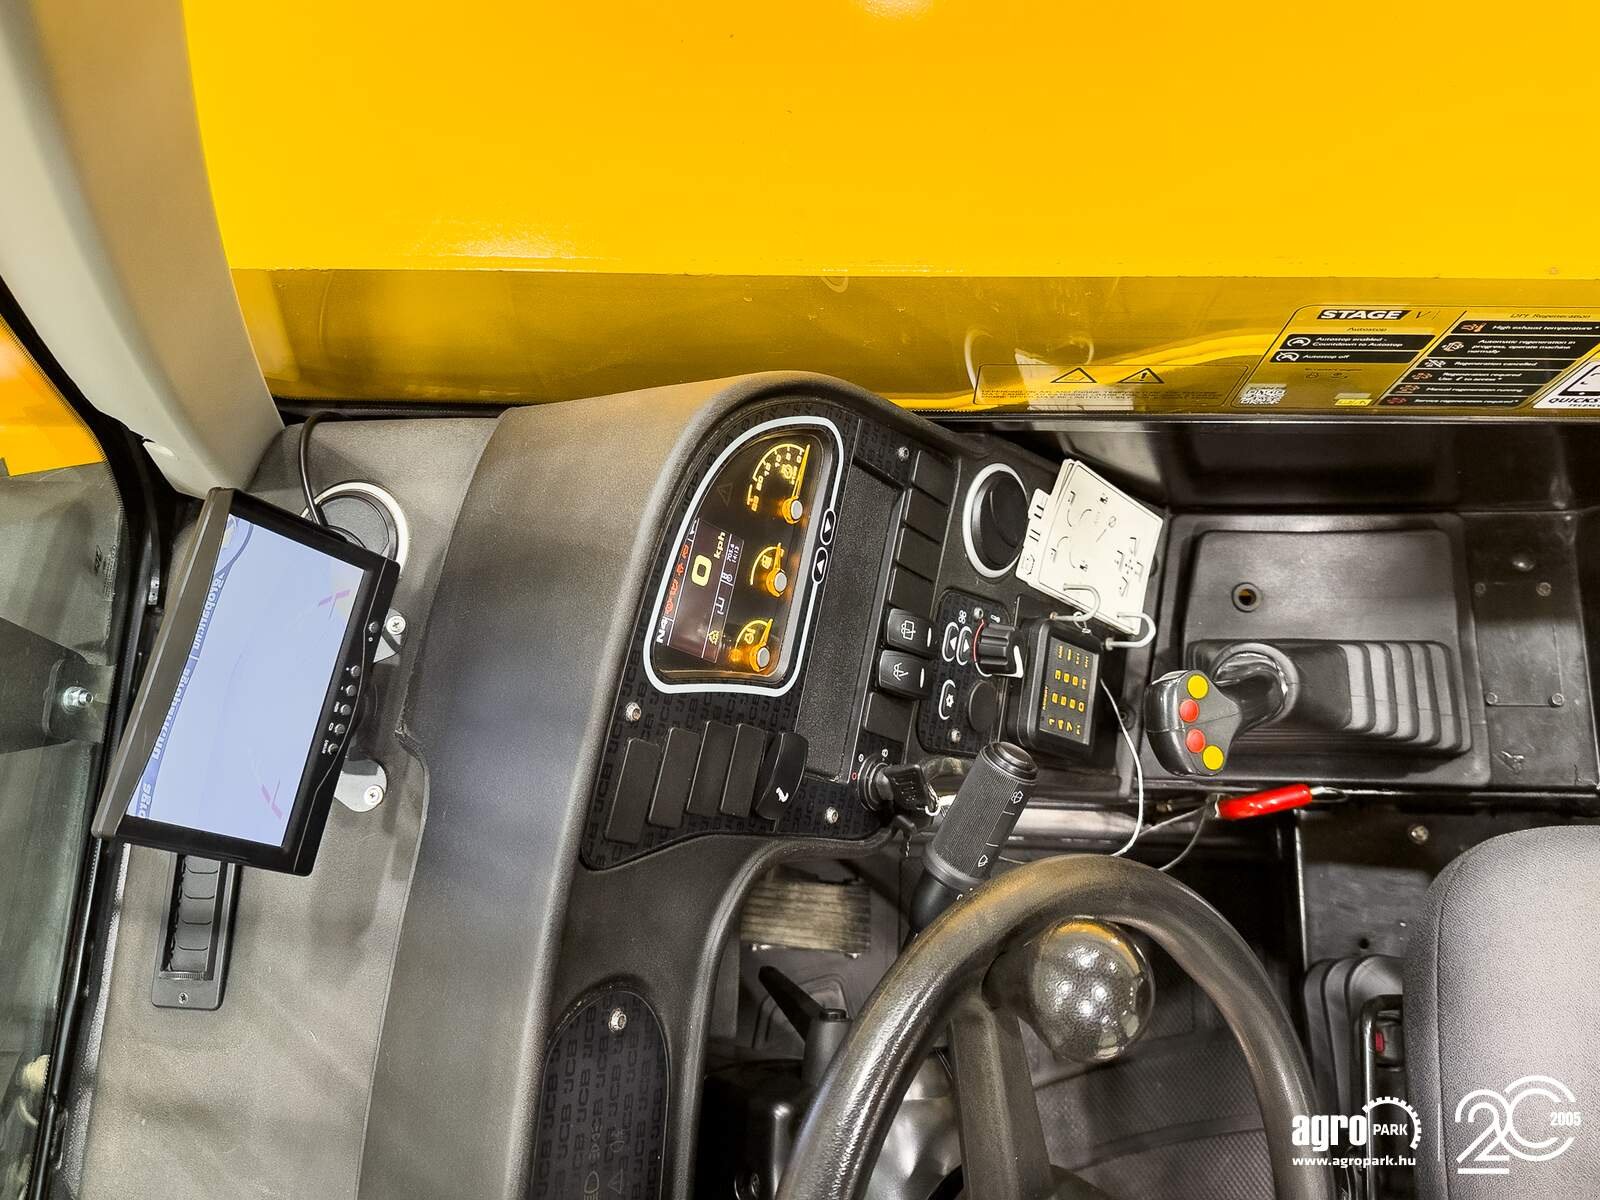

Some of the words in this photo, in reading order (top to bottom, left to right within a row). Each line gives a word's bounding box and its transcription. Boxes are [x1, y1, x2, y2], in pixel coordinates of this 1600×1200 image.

[1320, 310, 1403, 320] STAGE
[713, 531, 726, 559] kph
[691, 554, 713, 587] 0
